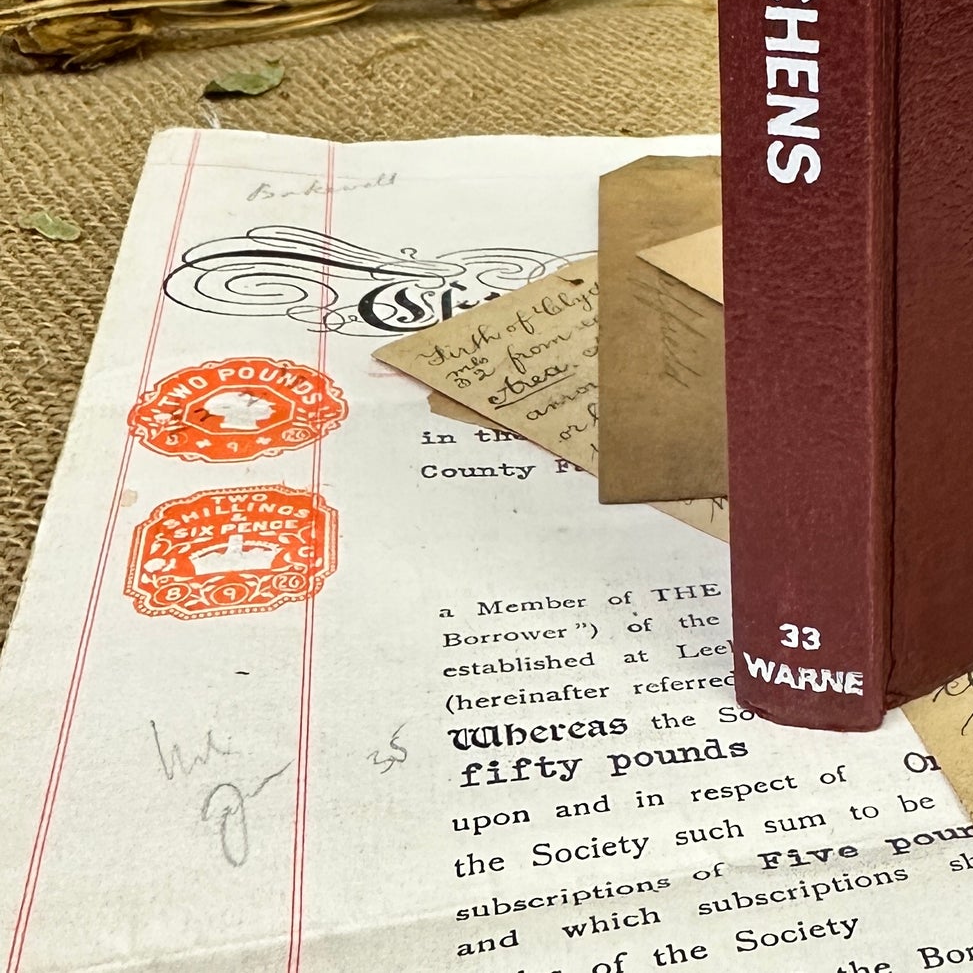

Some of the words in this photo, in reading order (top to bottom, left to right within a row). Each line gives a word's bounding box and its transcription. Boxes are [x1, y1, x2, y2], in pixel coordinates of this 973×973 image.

[157, 375, 209, 409] TWO
[217, 366, 324, 405] POUNDS
[421, 431, 456, 444] in
[420, 464, 537, 480] County
[209, 493, 269, 505] TWO
[162, 502, 311, 529] SHILLINGS
[174, 526, 214, 539] SIX
[221, 519, 300, 535] PENCE
[165, 586, 181, 601] 8
[223, 586, 237, 601] 9
[439, 607, 455, 619] a
[476, 596, 588, 616] Member
[608, 590, 633, 606] of
[651, 583, 722, 603] THE
[627, 618, 652, 633] of
[678, 613, 721, 629] the
[779, 623, 822, 651] 33
[442, 652, 596, 678] established
[623, 650, 649, 664] at
[743, 651, 865, 697] WARNE
[444, 685, 611, 714] (hereinafter
[447, 717, 629, 751] Whereas
[651, 713, 697, 730] the
[459, 755, 584, 790] fifty
[606, 738, 750, 778] pounds
[451, 808, 532, 835] upon
[555, 795, 612, 818] and
[636, 790, 666, 809] in
[690, 774, 799, 806] respect
[819, 765, 848, 785] of
[454, 856, 506, 879] the
[532, 833, 650, 869] Society
[675, 819, 746, 847] such
[764, 810, 828, 835] sum
[850, 803, 880, 821] to
[897, 794, 936, 814] be
[455, 875, 672, 923] subscriptions
[692, 862, 725, 882] of
[756, 843, 860, 871] Five
[456, 930, 521, 958] and
[562, 908, 663, 939] which
[698, 866, 910, 917] subscriptions
[653, 943, 710, 967] the
[735, 915, 861, 955] Society
